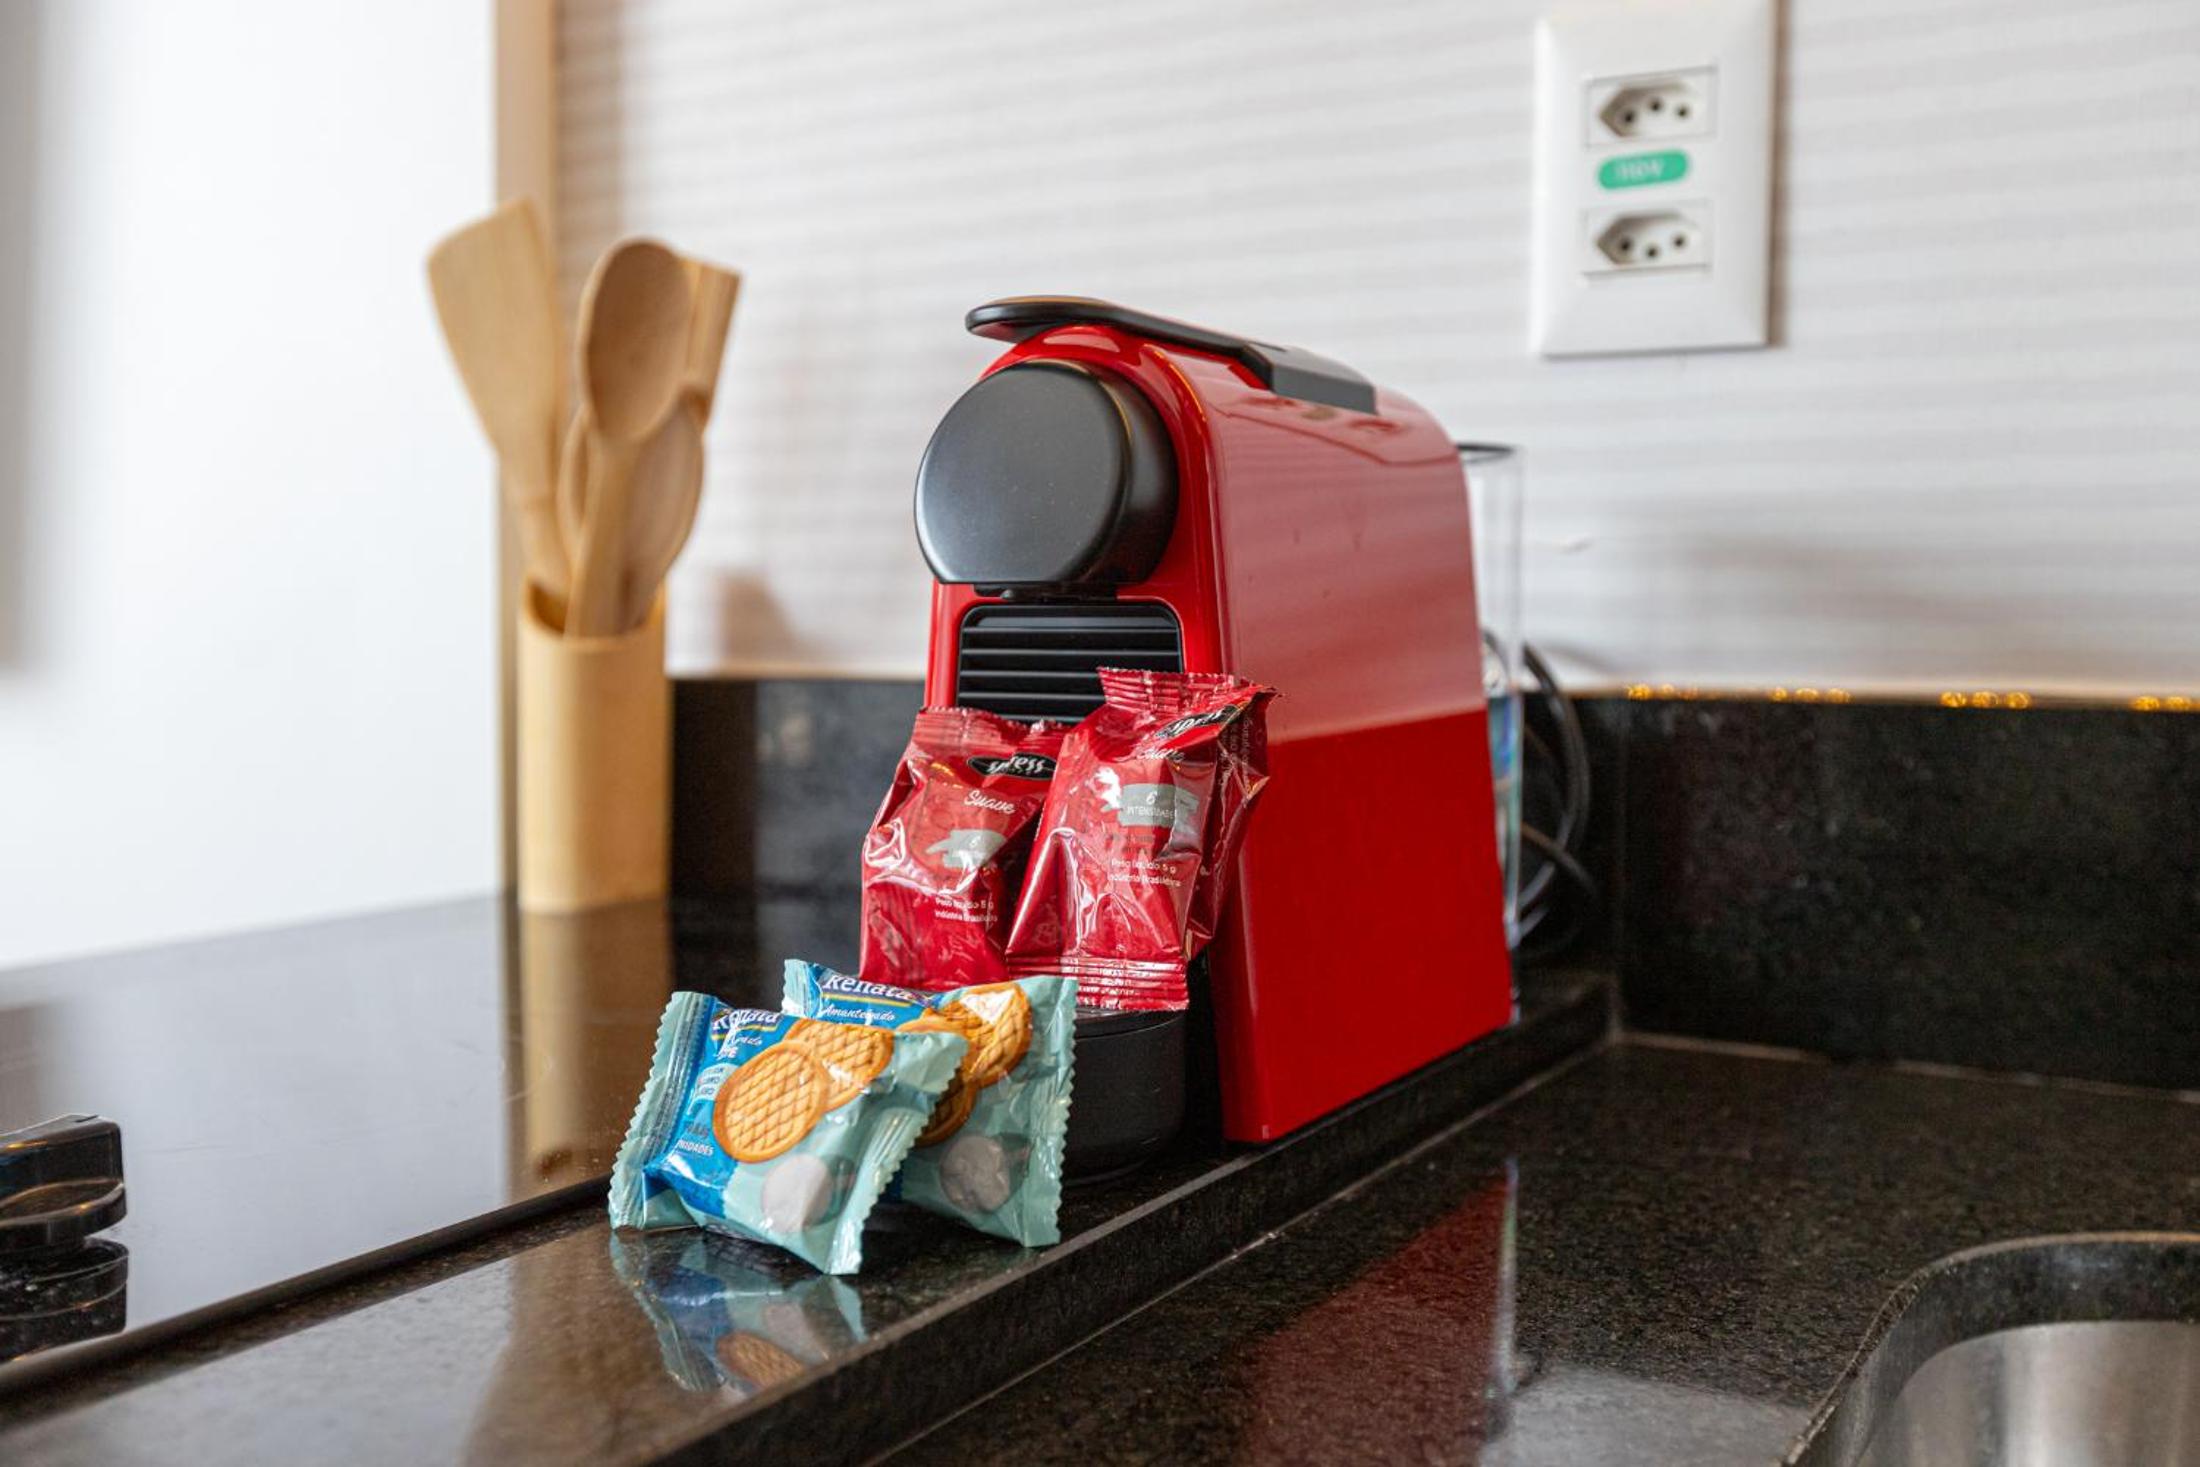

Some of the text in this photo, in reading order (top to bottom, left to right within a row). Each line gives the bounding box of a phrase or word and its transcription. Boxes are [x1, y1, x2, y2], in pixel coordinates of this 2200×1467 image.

[964, 789, 1016, 814] Suave
[1146, 791, 1158, 806] 6
[1162, 863, 1169, 872] 5
[1169, 865, 1177, 875] g
